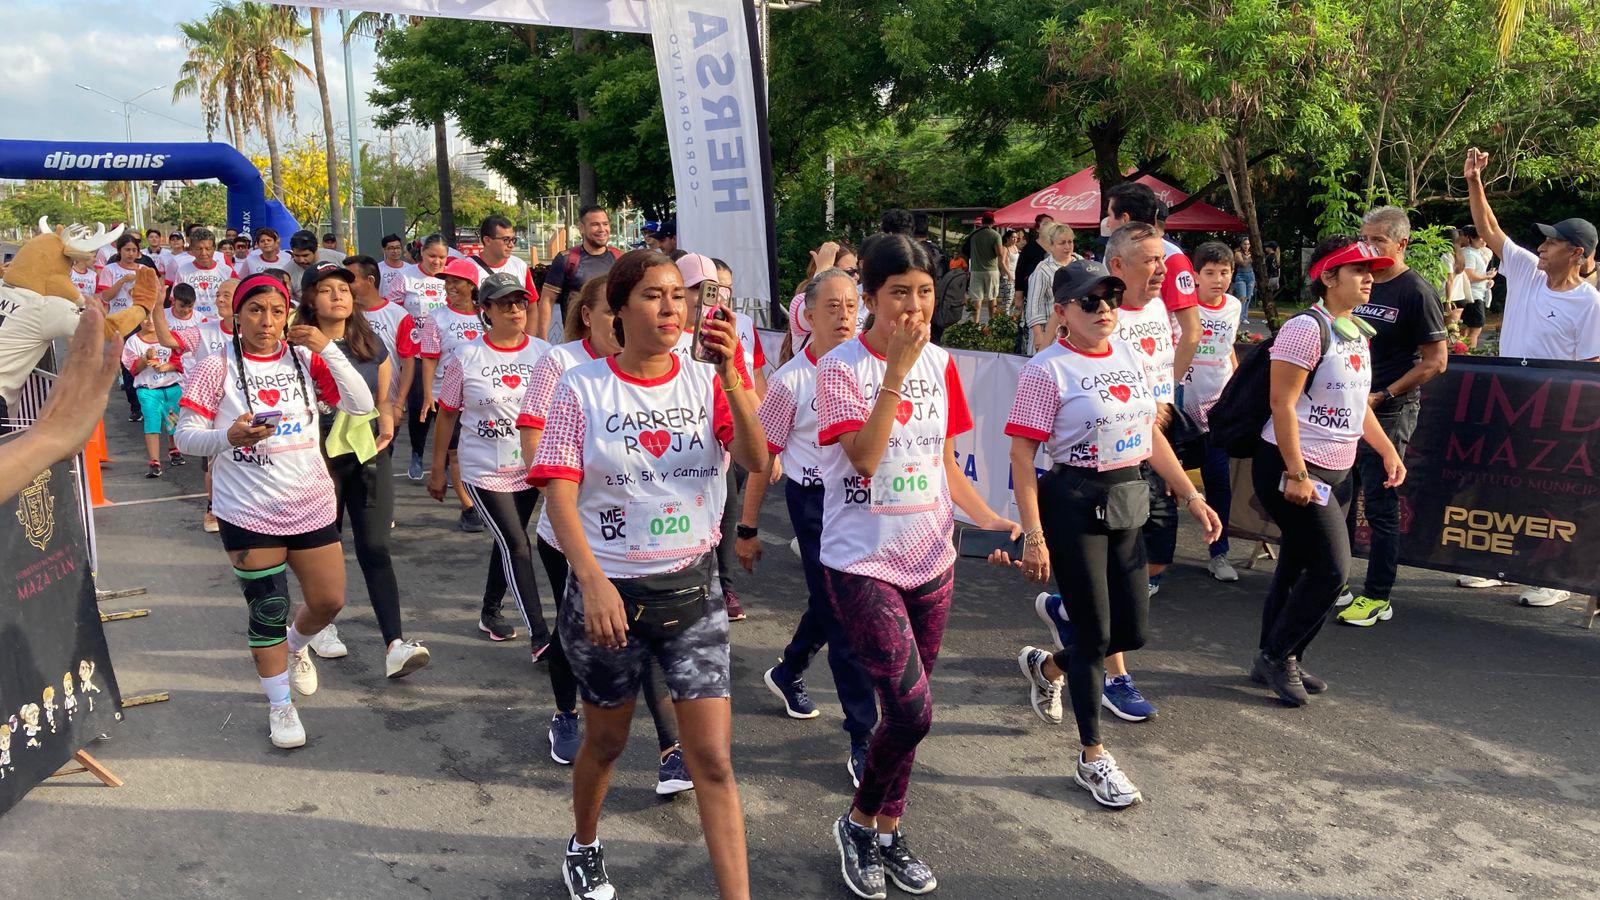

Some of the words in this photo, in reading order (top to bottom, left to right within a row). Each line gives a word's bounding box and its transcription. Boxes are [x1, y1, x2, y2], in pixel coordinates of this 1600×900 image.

[43, 151, 166, 171] dportenis
[1177, 275, 1193, 289] 115
[1119, 321, 1168, 341] CARRERA
[864, 379, 942, 401] CRERA
[1081, 370, 1144, 392] CARRERA
[1153, 383, 1172, 398] 049
[605, 405, 707, 434] CARRERA
[1308, 415, 1350, 430] DONA
[477, 427, 515, 439] DONA
[889, 437, 902, 448] 5K
[1115, 434, 1142, 453] 048
[605, 472, 636, 486] 2.5K,
[641, 470, 656, 482] 5K
[661, 472, 668, 483] y
[892, 474, 928, 493] 016
[1528, 478, 1600, 496] MUNICIP
[650, 515, 691, 536] 020
[1443, 505, 1577, 543] POWER
[1441, 526, 1514, 555] ADE
